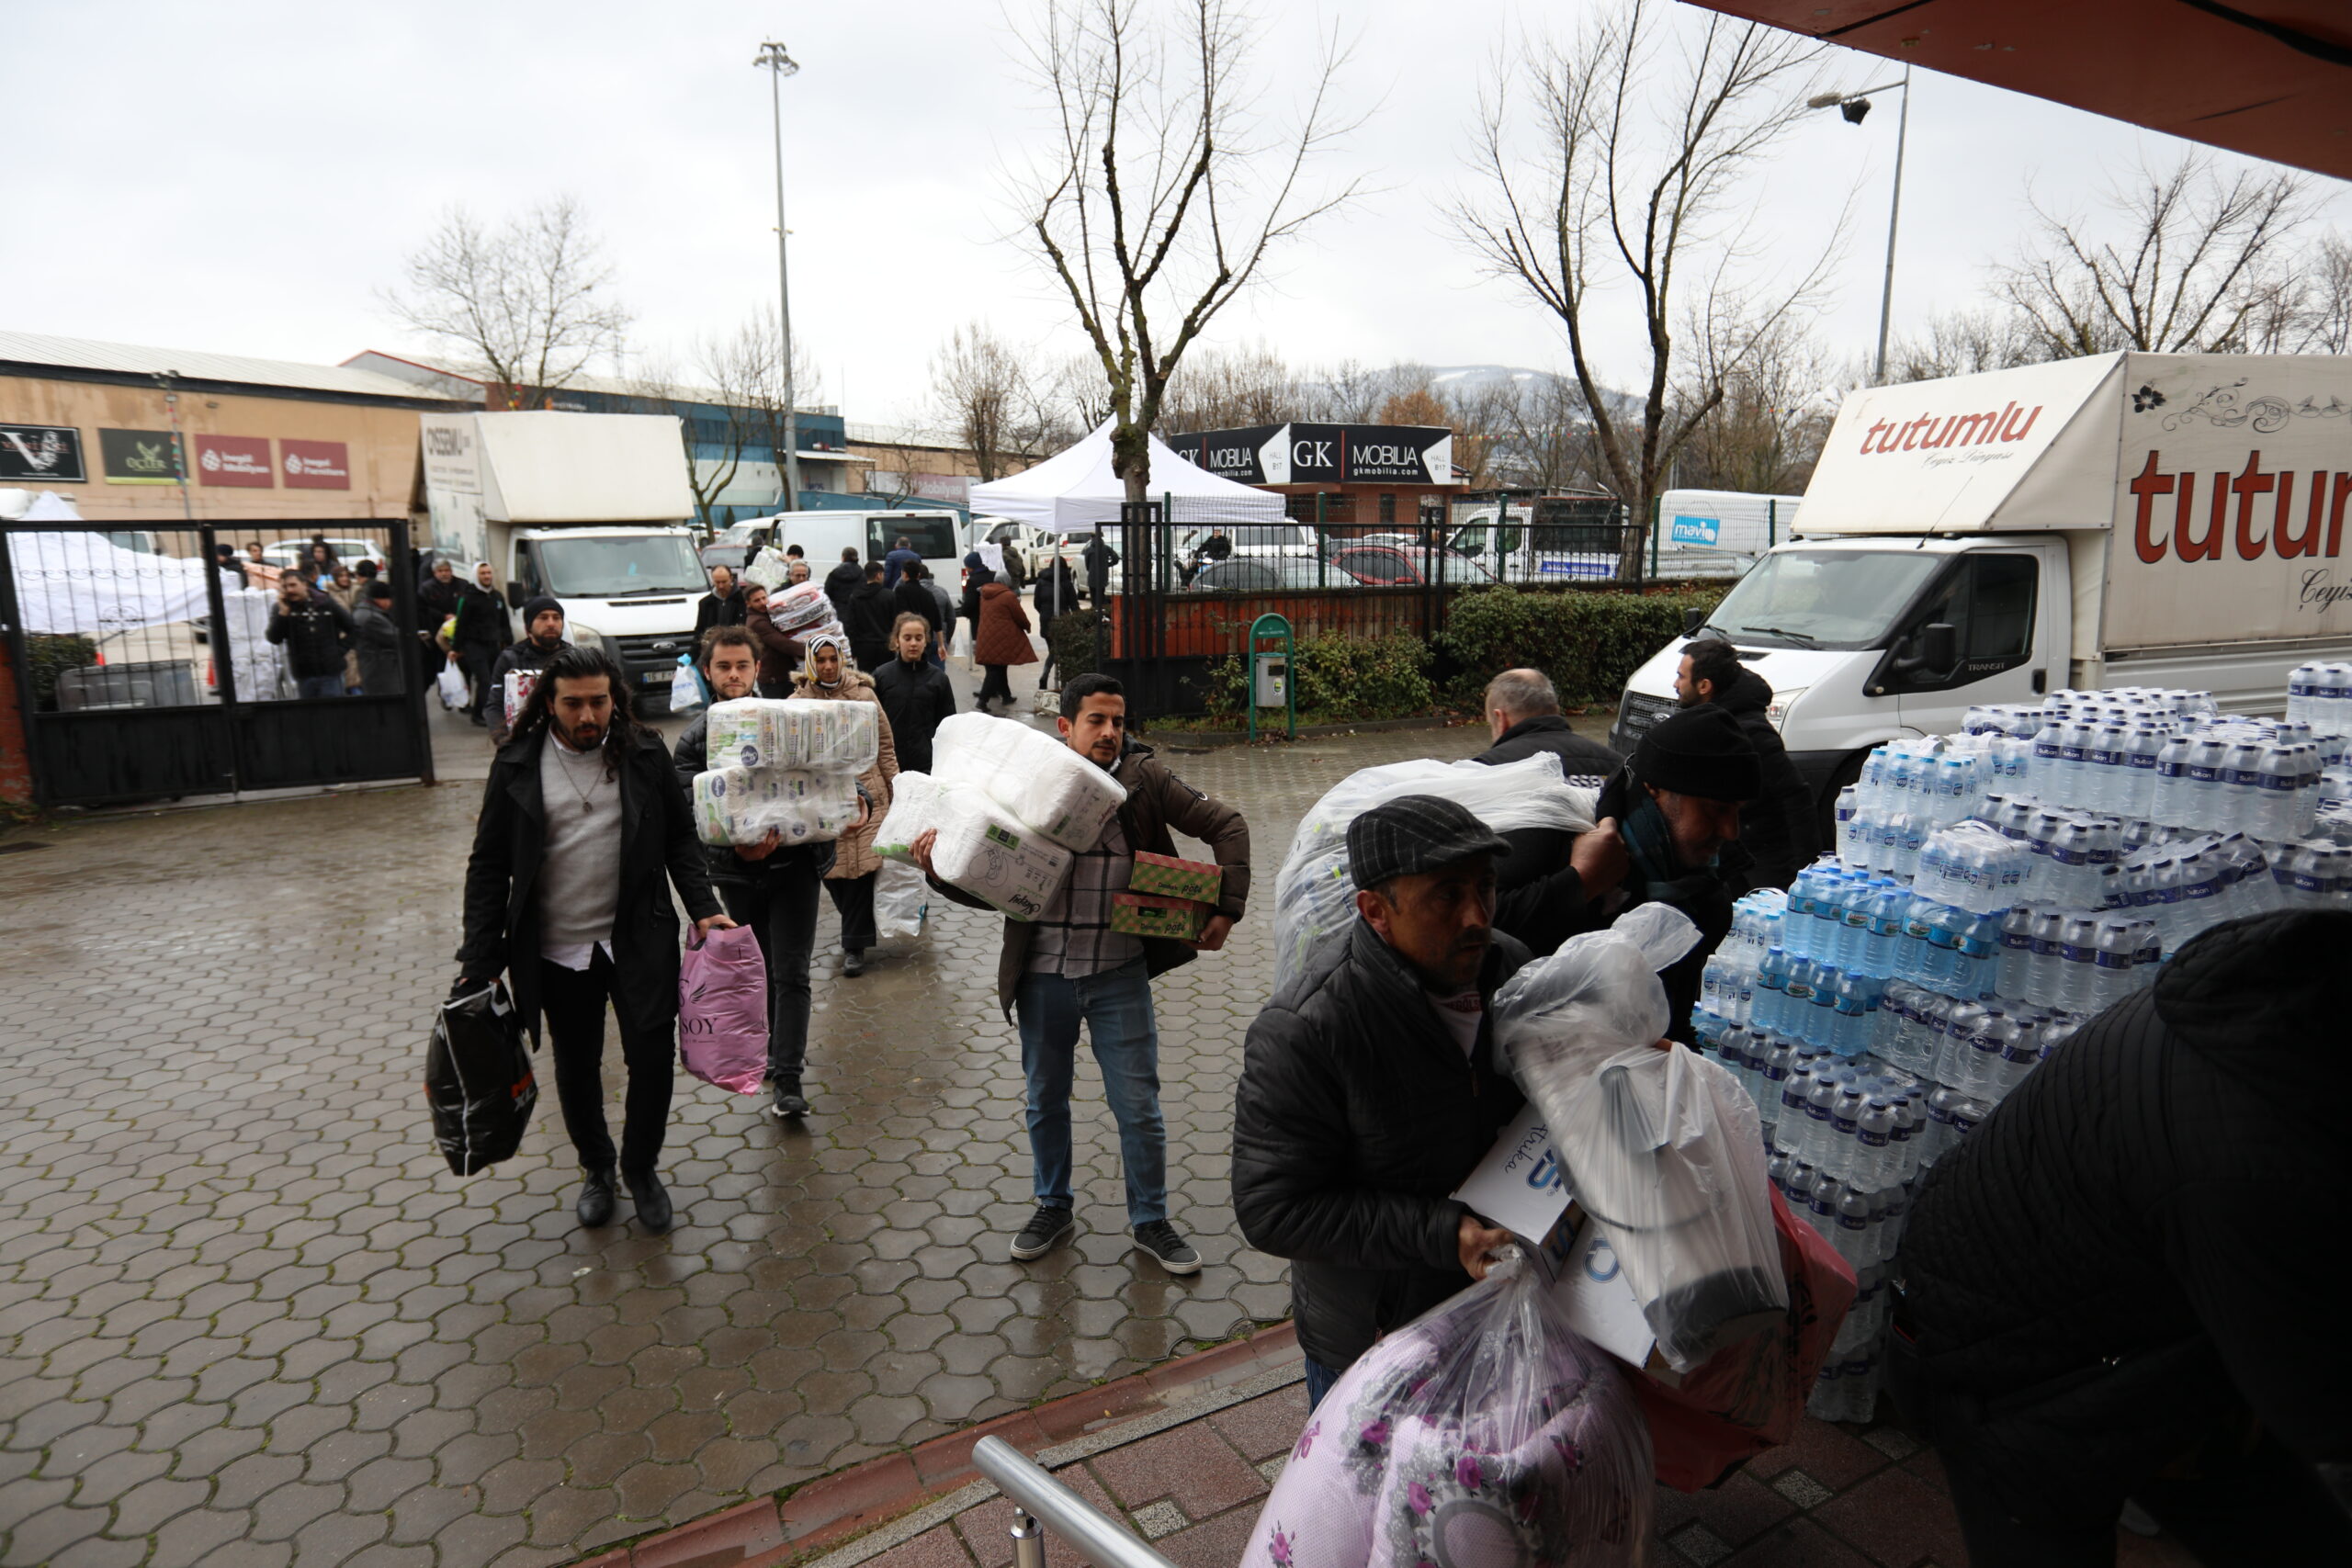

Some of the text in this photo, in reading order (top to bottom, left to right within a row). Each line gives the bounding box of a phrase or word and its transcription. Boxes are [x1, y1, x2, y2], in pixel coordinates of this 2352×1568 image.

[1860, 400, 2043, 455] tutumlu
[1210, 447, 1253, 468] MOBILIA
[1293, 440, 1333, 468] GK
[1353, 445, 1419, 466] MOBILIA
[1353, 468, 1419, 476] gkmobilia.com
[1968, 662, 2005, 671] TRANSIT
[2134, 758, 2154, 766] Sultan
[2191, 770, 2211, 778] Sultan
[2186, 887, 2209, 896] Sultan
[682, 1017, 718, 1036] SOY
